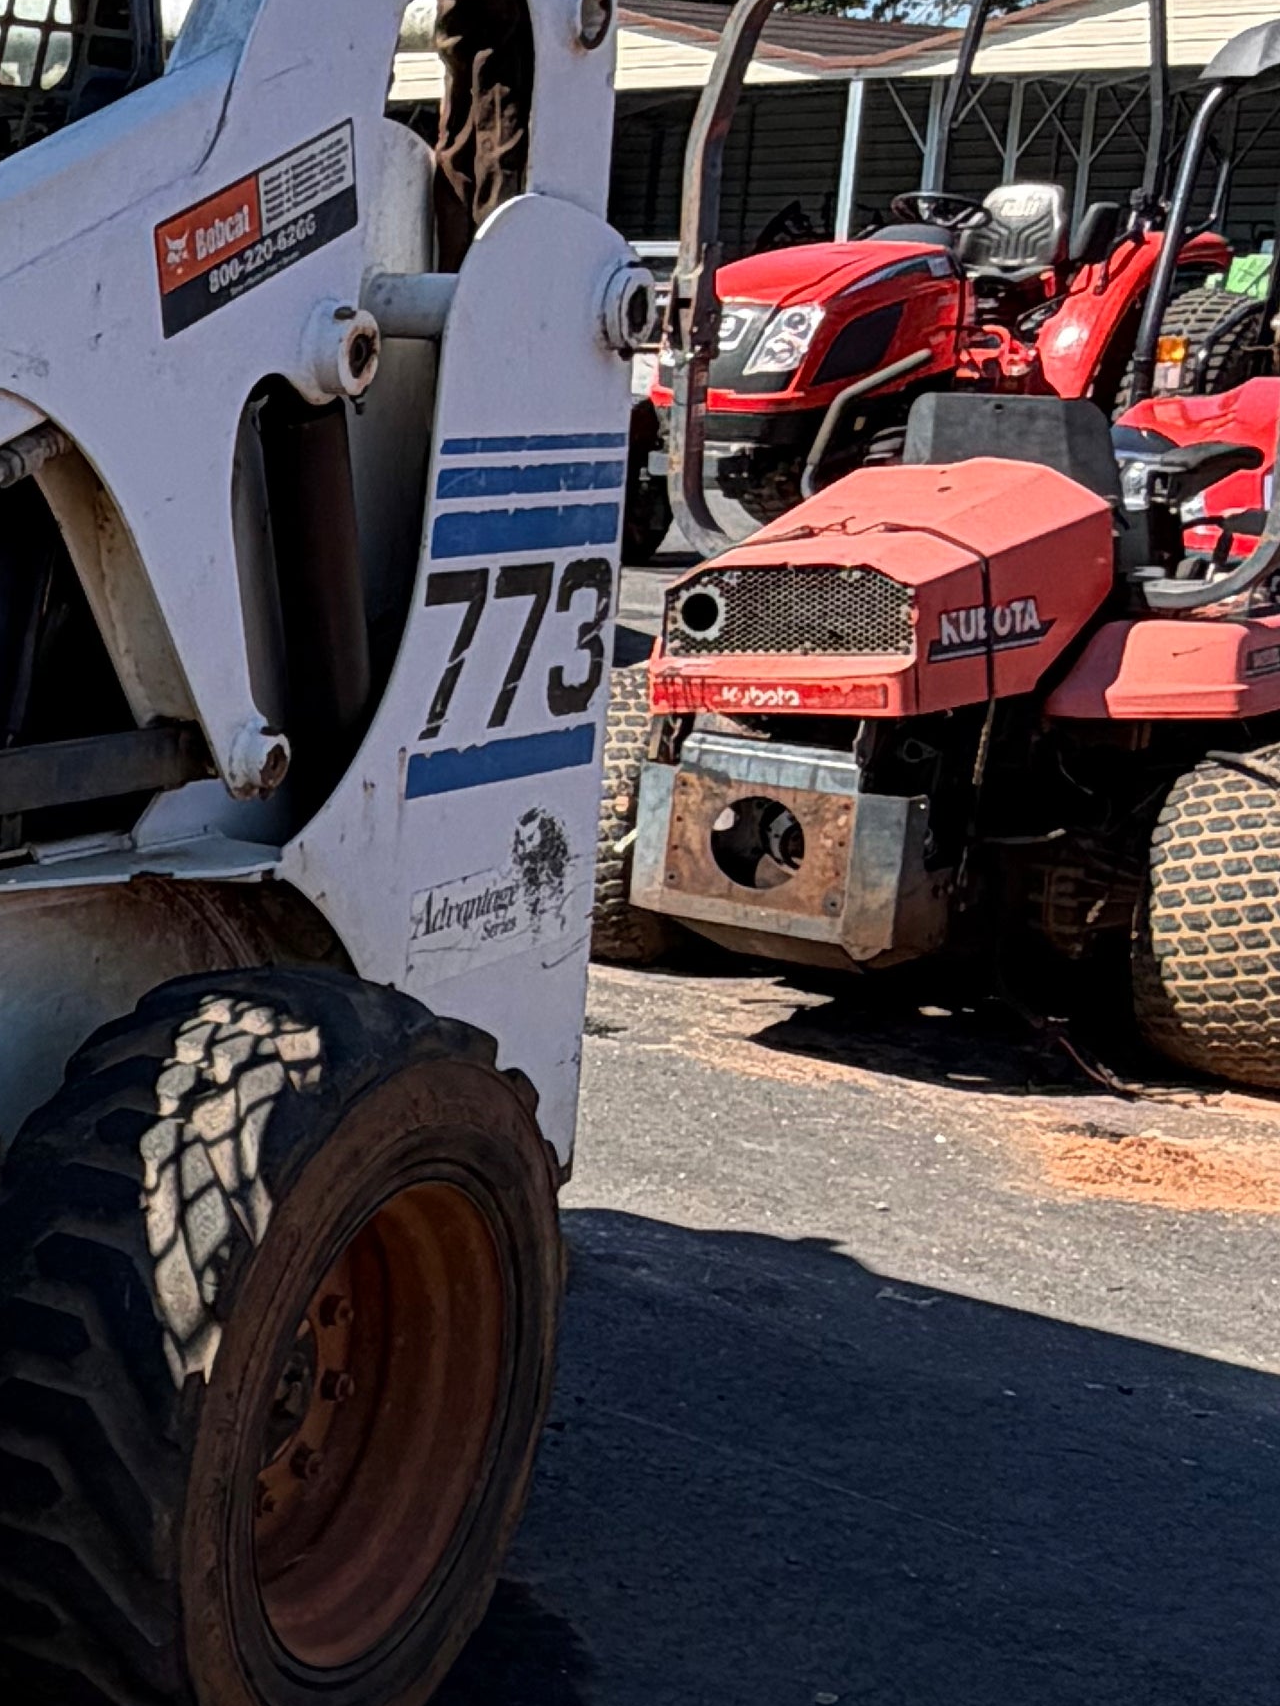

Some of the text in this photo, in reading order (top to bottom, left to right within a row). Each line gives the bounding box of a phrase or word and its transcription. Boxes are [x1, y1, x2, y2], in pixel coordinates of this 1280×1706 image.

[195, 204, 250, 261] Bobcat
[418, 557, 613, 741] 773
[720, 685, 801, 707] Kubota
[410, 885, 517, 940] Advantage
[481, 915, 517, 941] Series
